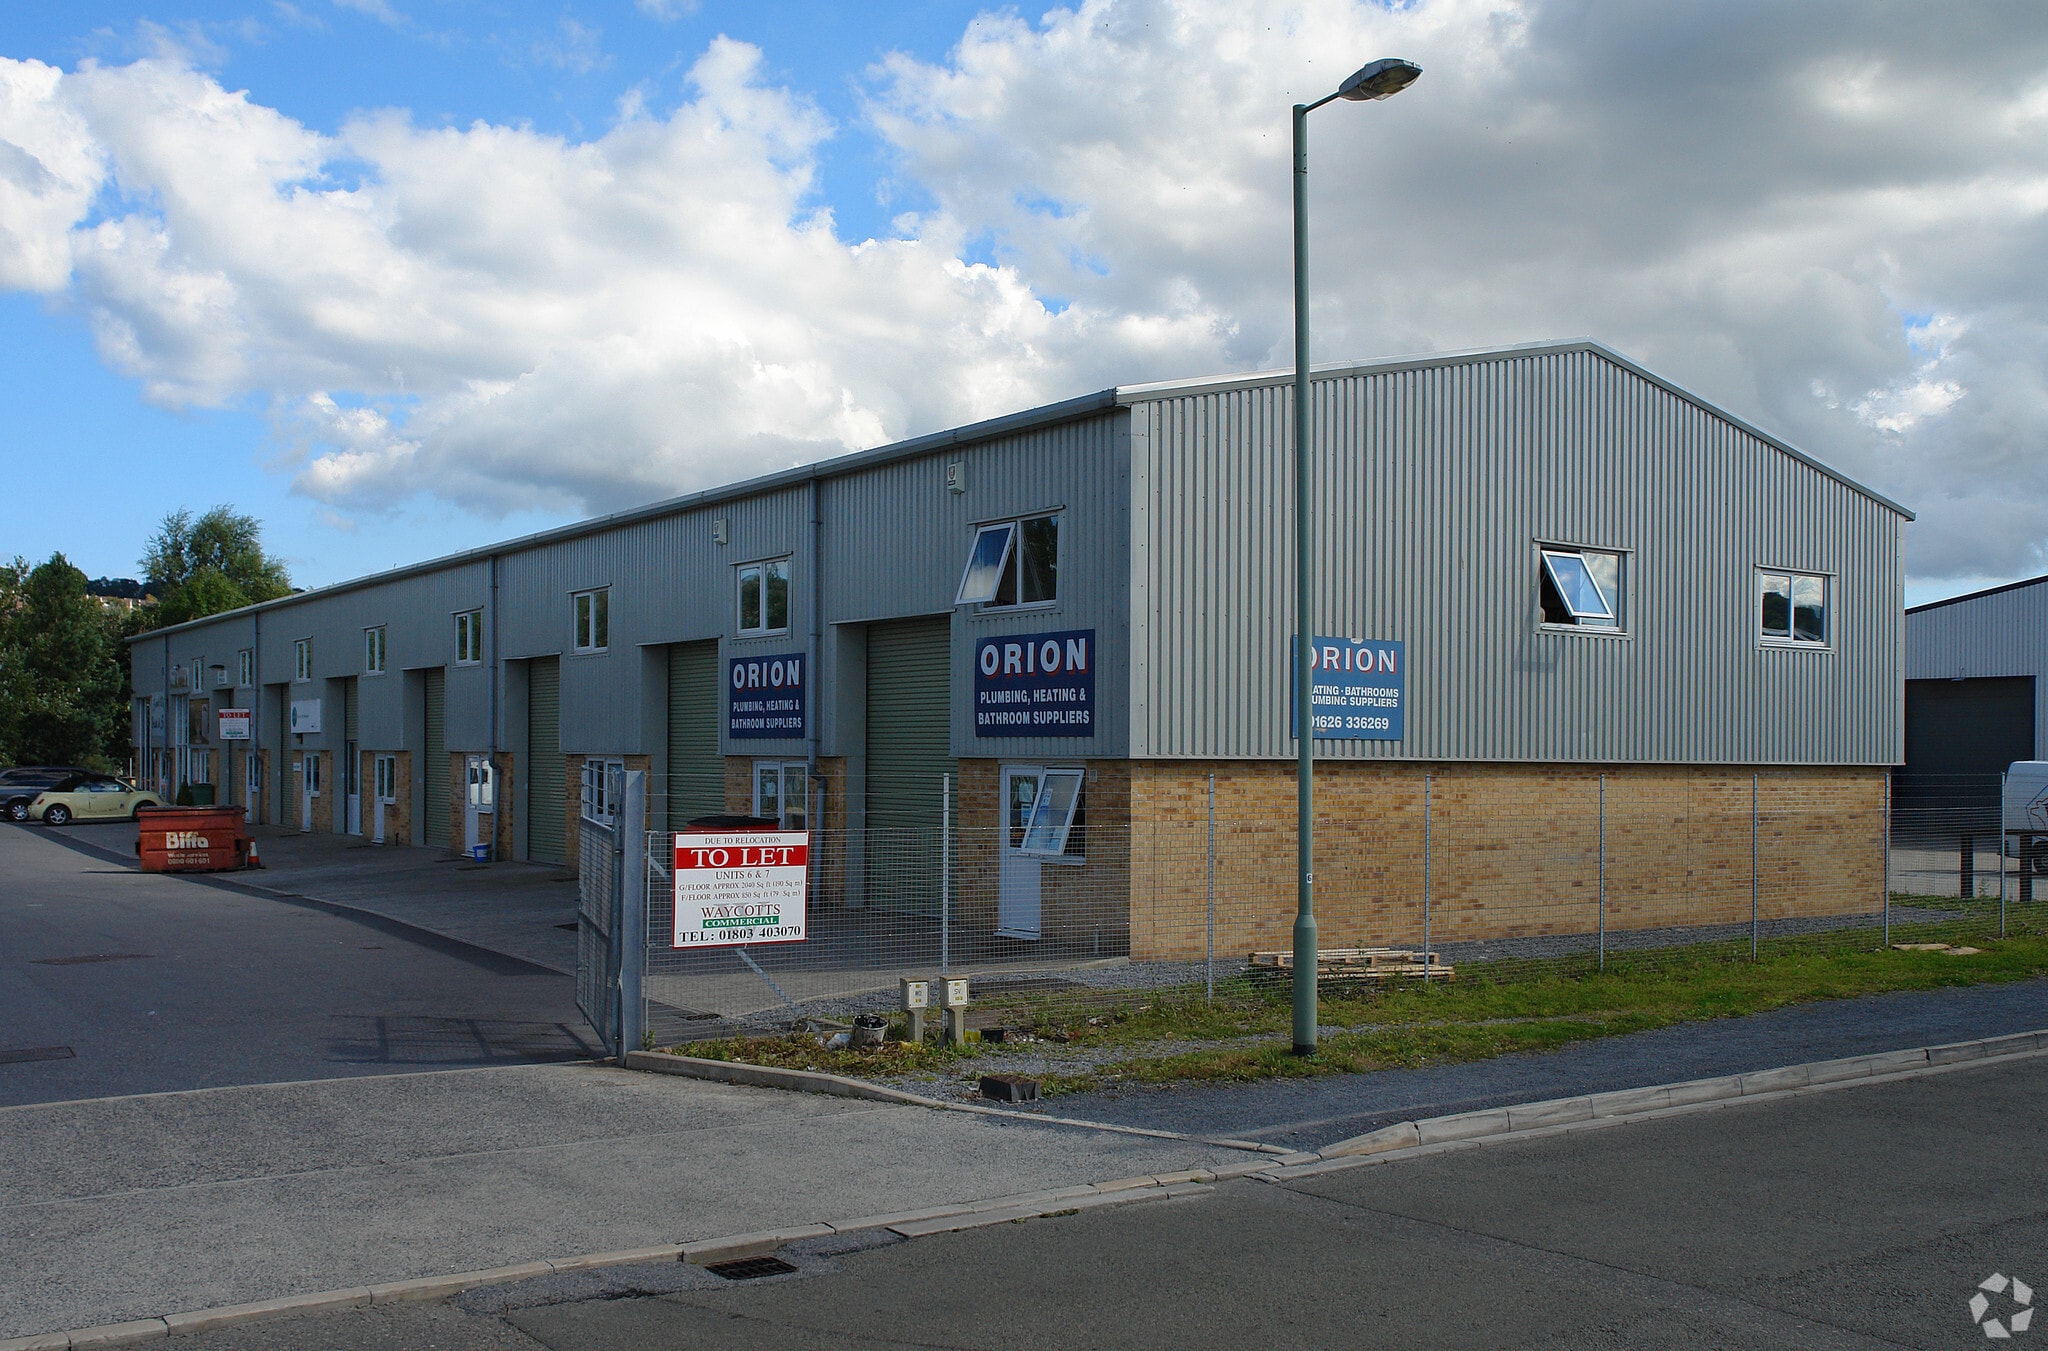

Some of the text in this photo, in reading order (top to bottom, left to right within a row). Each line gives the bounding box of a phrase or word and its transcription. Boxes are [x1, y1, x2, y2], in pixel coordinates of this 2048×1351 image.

[980, 638, 1087, 679] ORION
[733, 660, 800, 691] ORION
[980, 687, 1086, 705] PLUMBING, HEATING &
[1312, 685, 1399, 698] ATING BATHROOMS
[733, 699, 800, 713] PLUMBING, HEATING &
[1312, 696, 1398, 708] UMBING SUPPLIERS
[731, 717, 802, 729] BATHROOM SUPPLIERS
[978, 710, 1090, 725] BATHROOM SUPPLIERS
[1312, 716, 1389, 729] 1626 336269
[166, 831, 209, 849] Biffa
[704, 837, 721, 845] DUE
[735, 836, 782, 844] RELOCATION
[690, 847, 795, 868] TO LET
[715, 870, 770, 880] UNITS 6 & 7
[679, 883, 711, 891] G/FLOOR
[713, 882, 740, 890] APPROX
[756, 881, 764, 889] Sq
[681, 893, 712, 902] F/FLOOR
[713, 892, 740, 900] APPROX
[783, 890, 791, 898] Sq
[701, 904, 781, 918] WAYCOTTS
[705, 917, 777, 928] COMMERCIAL
[679, 926, 801, 943] TEL: 01803 403070
